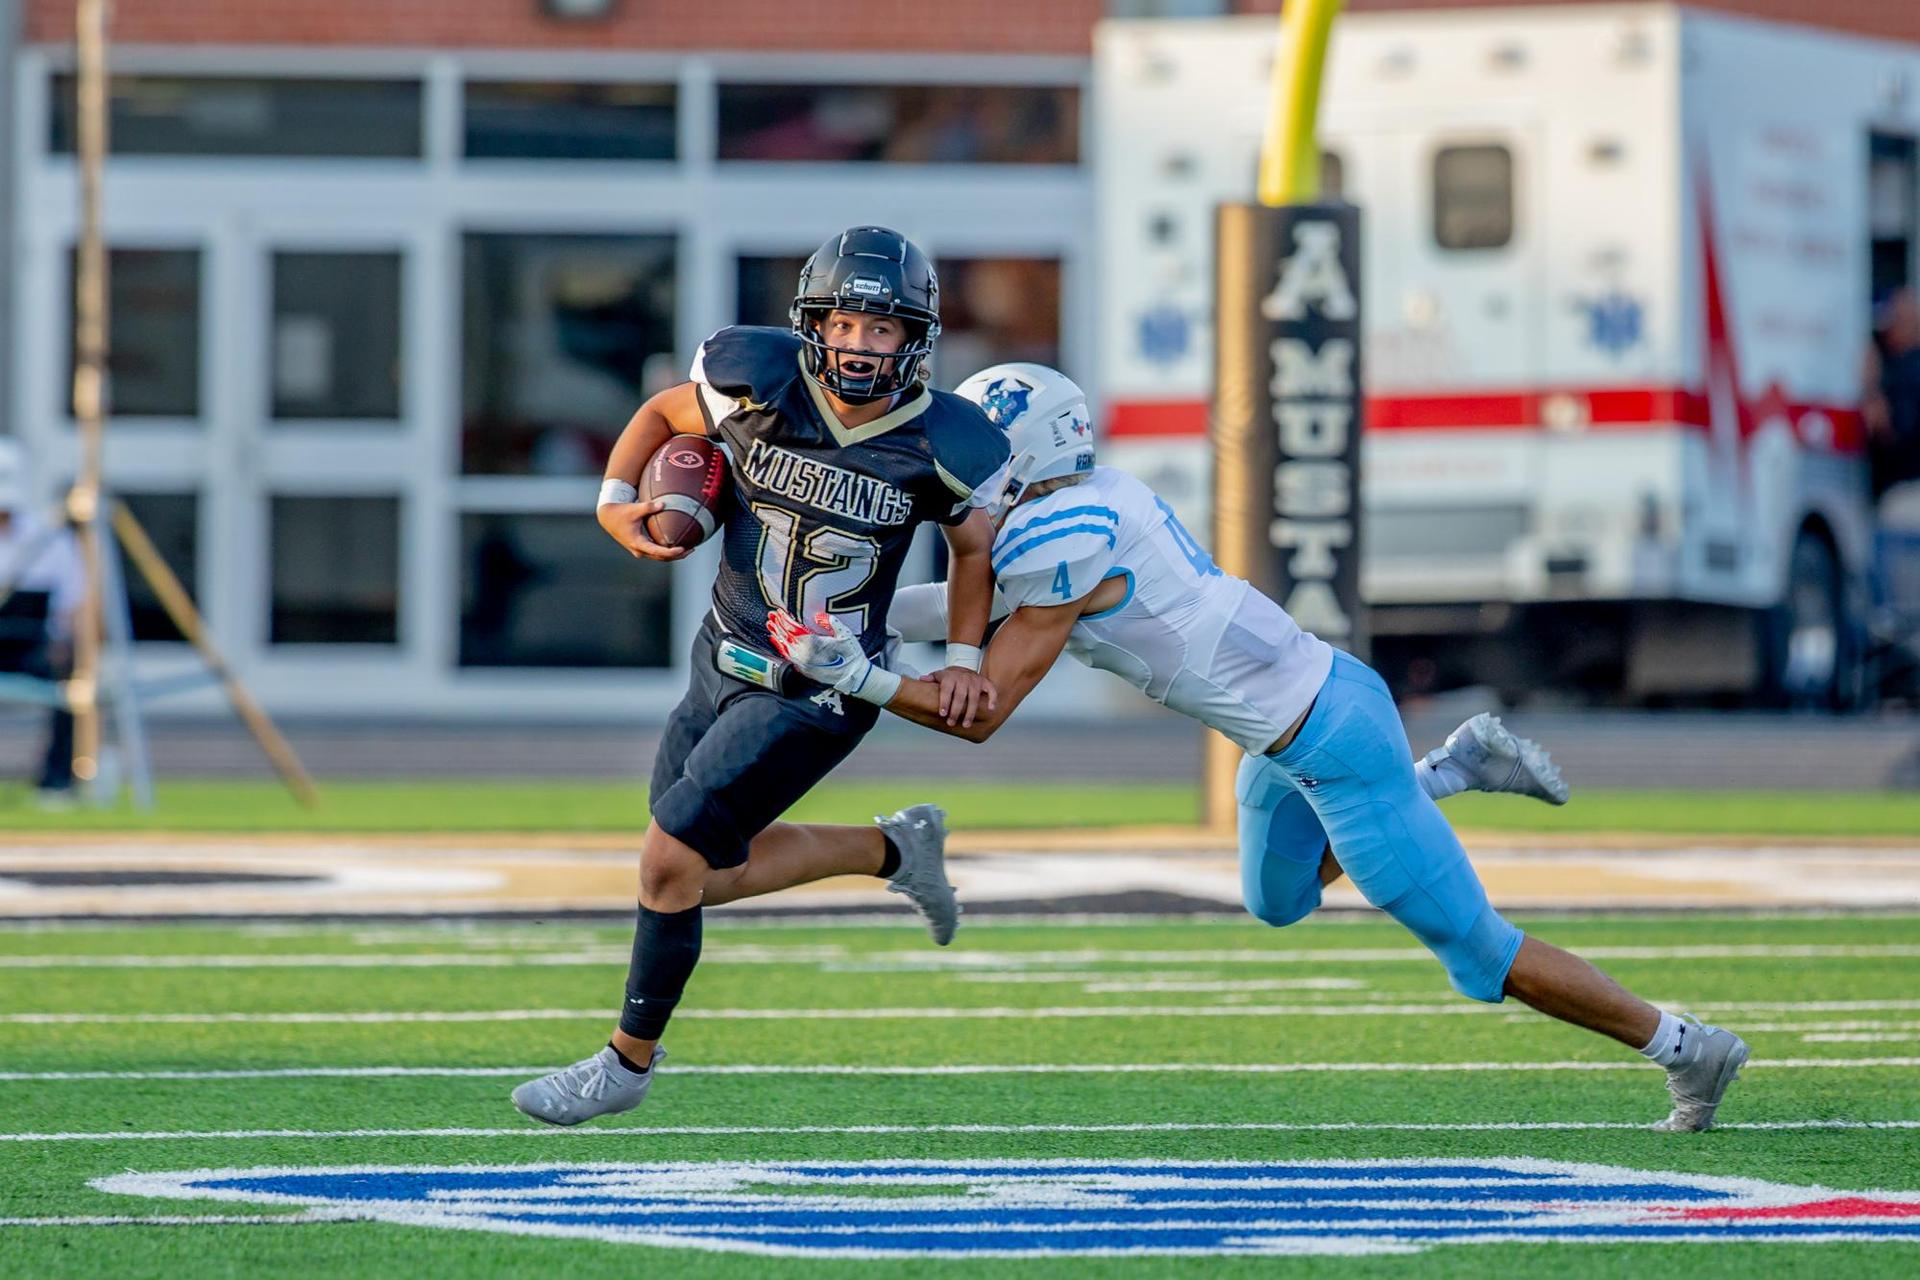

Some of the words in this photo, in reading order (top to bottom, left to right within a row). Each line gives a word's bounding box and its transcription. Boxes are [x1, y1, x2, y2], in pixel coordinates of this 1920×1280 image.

[856, 283, 879, 291] schutt
[743, 438, 915, 525] MUSTANGS
[1269, 336, 1354, 648] MUSTA
[751, 501, 882, 637] 12
[1052, 560, 1072, 600] 4
